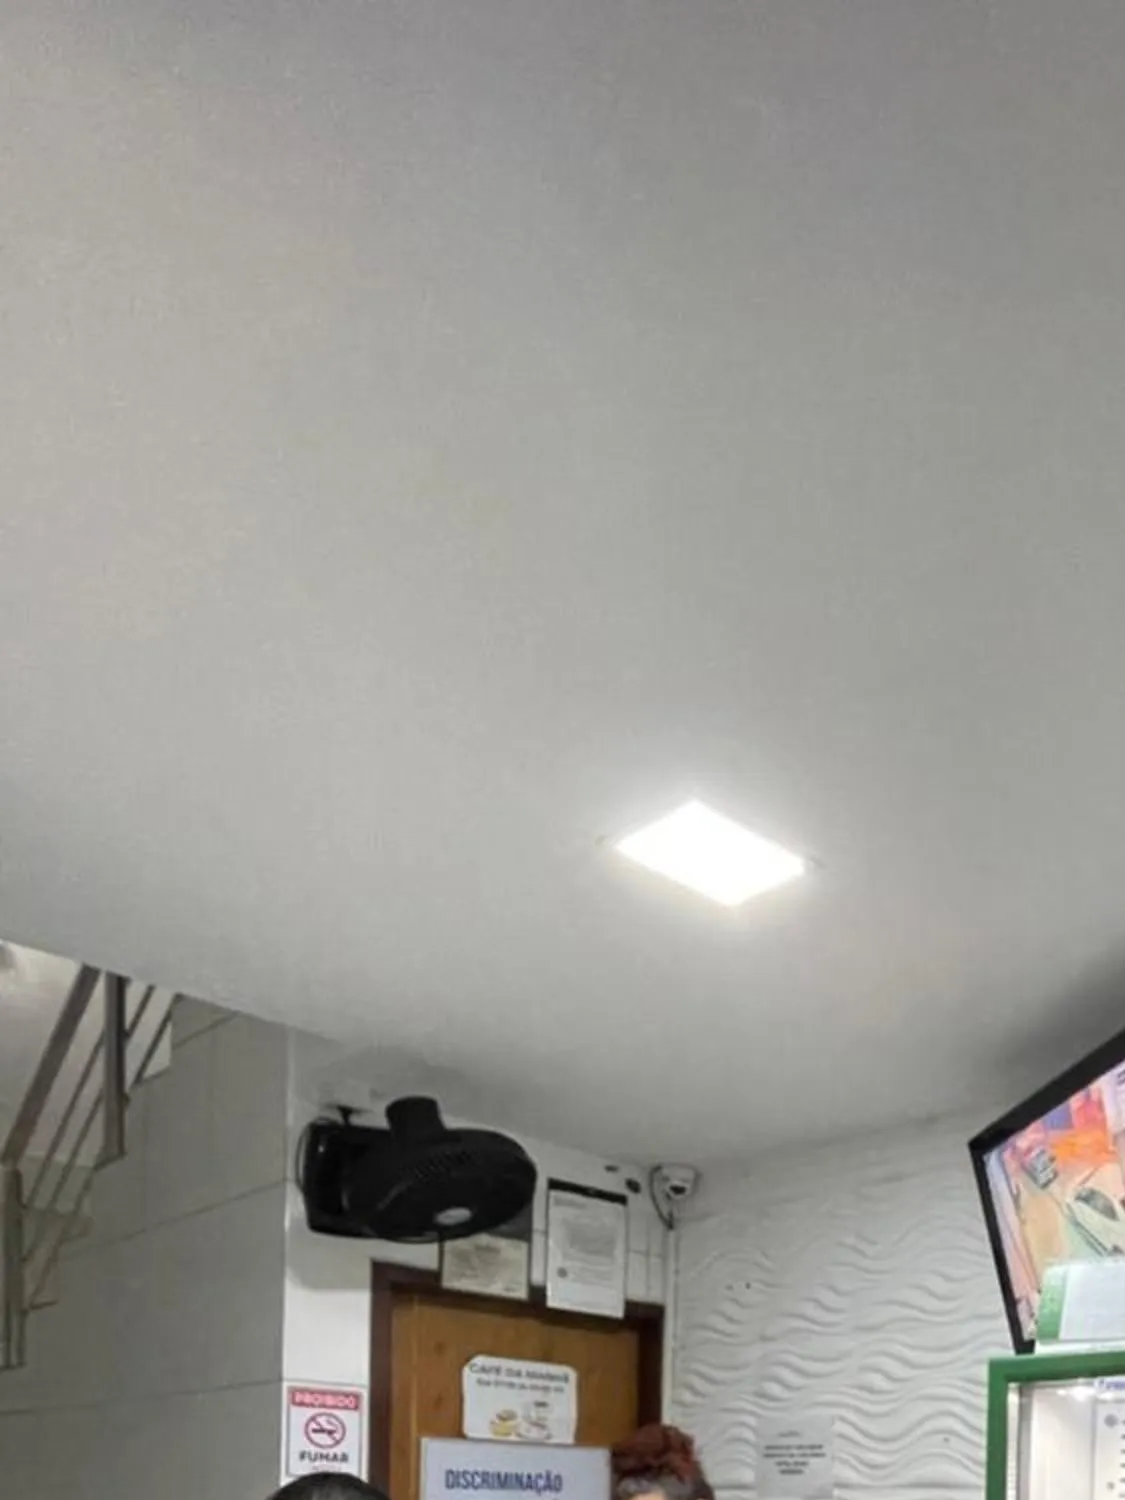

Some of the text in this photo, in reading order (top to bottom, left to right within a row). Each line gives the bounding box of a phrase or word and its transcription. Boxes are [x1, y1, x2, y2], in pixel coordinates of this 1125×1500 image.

[294, 1391, 357, 1409] PROIBIDO
[299, 1450, 349, 1462] FUMAR
[445, 1470, 563, 1495] DISCRIMINAÇÃO
